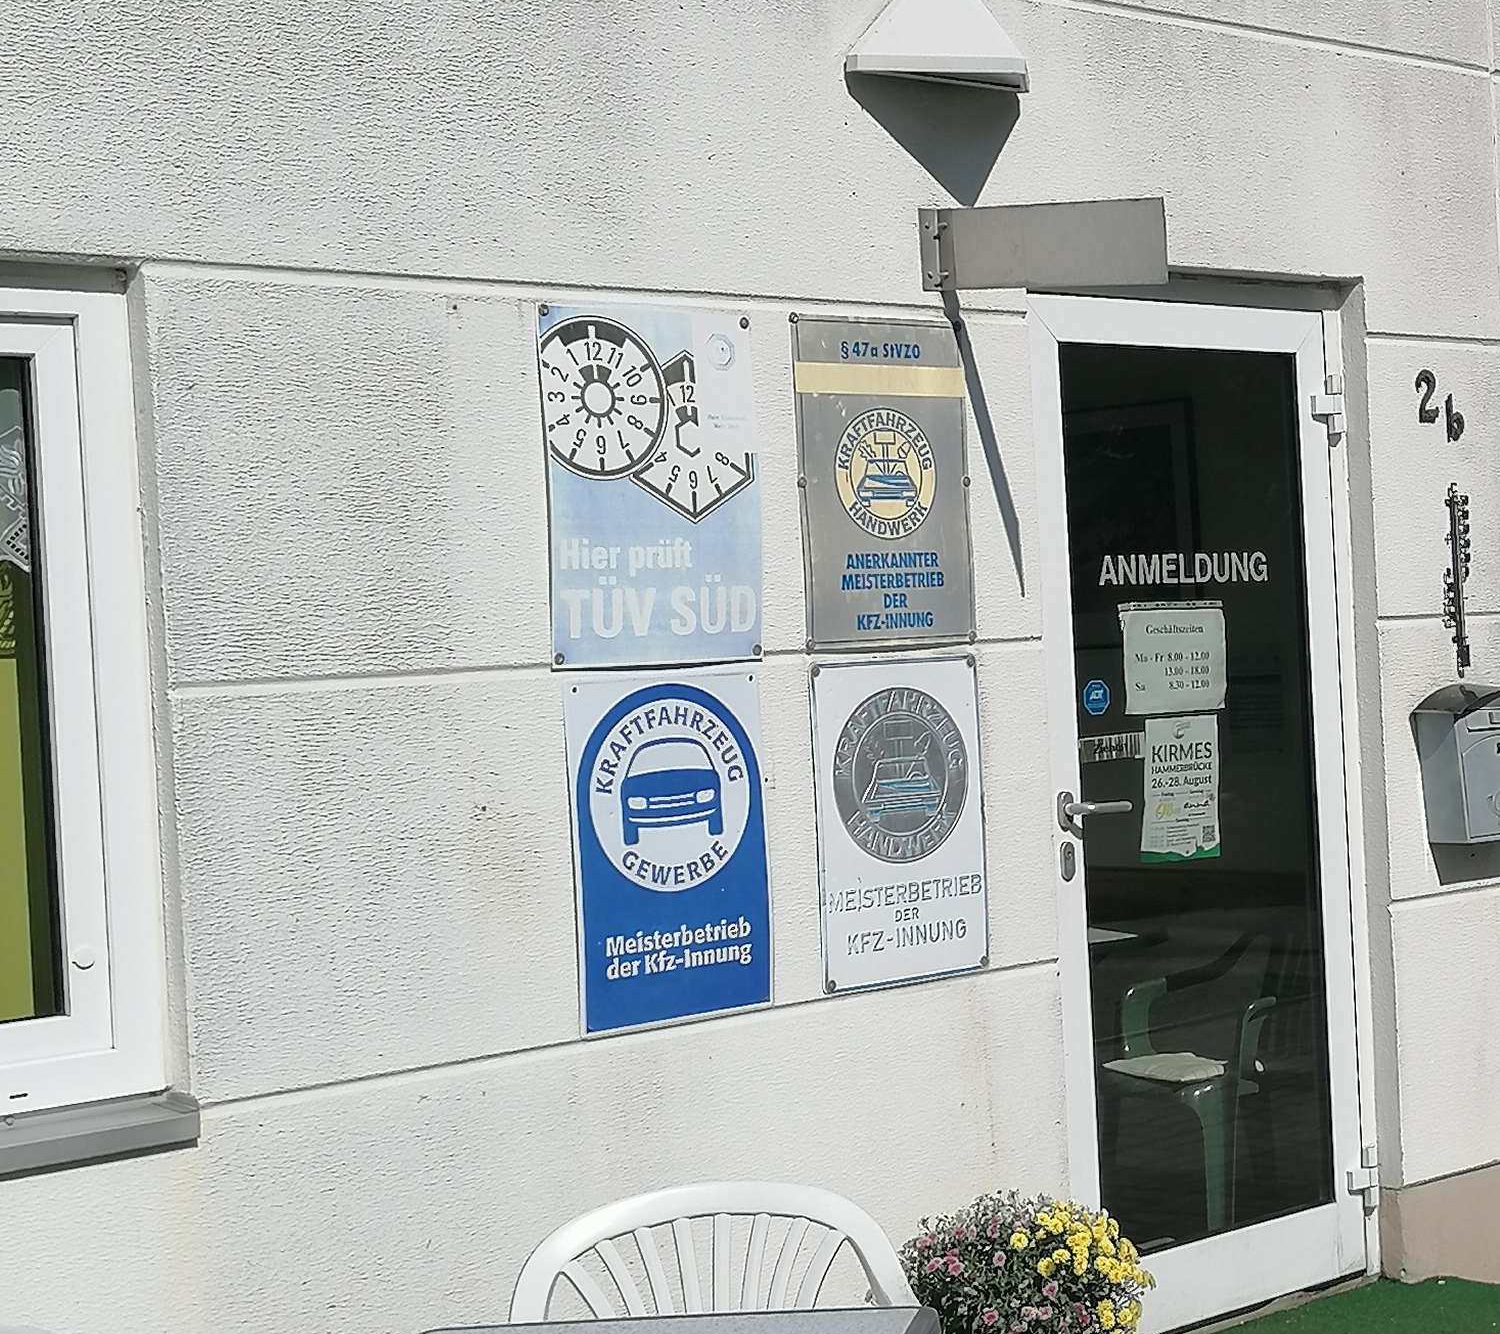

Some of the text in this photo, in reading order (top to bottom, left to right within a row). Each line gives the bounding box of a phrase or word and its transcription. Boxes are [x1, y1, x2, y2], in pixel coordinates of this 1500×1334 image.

[565, 348, 579, 365] 1
[584, 341, 603, 361] 12
[607, 347, 624, 369] 11
[840, 341, 921, 359] § 47a StVZO
[551, 366, 569, 383] 2
[622, 365, 643, 387] 10
[547, 391, 566, 402] 3
[679, 384, 696, 403] 12
[556, 413, 571, 426] 4
[627, 415, 644, 430] 8
[573, 428, 587, 449] 5
[617, 430, 630, 449] 7
[838, 412, 933, 470] KRAFTFAHRZEUG
[848, 501, 928, 536] HANDWERK
[559, 536, 692, 577] Hier prüft
[846, 552, 939, 570] ANERKANNTER
[1099, 551, 1269, 586] ANMELDUNG
[841, 572, 945, 591] MEISTERBETRIEB
[560, 574, 757, 639] TÜV SÜD
[883, 593, 908, 609] DER
[856, 612, 934, 631] KFZ-INNUNG
[595, 705, 744, 796] KRAFTFAHRZEUG
[1151, 741, 1212, 763] KIRMES
[1183, 774, 1212, 787] August
[847, 808, 956, 858] HANDWERK
[621, 839, 729, 886] GEWERBE
[828, 873, 983, 914] MEISTERBETRIEB
[894, 907, 920, 923] DER
[606, 916, 752, 957] Meisterbetrieb
[847, 918, 968, 955] KFZ-INNUNG
[606, 942, 753, 980] der Kfz-Innung
